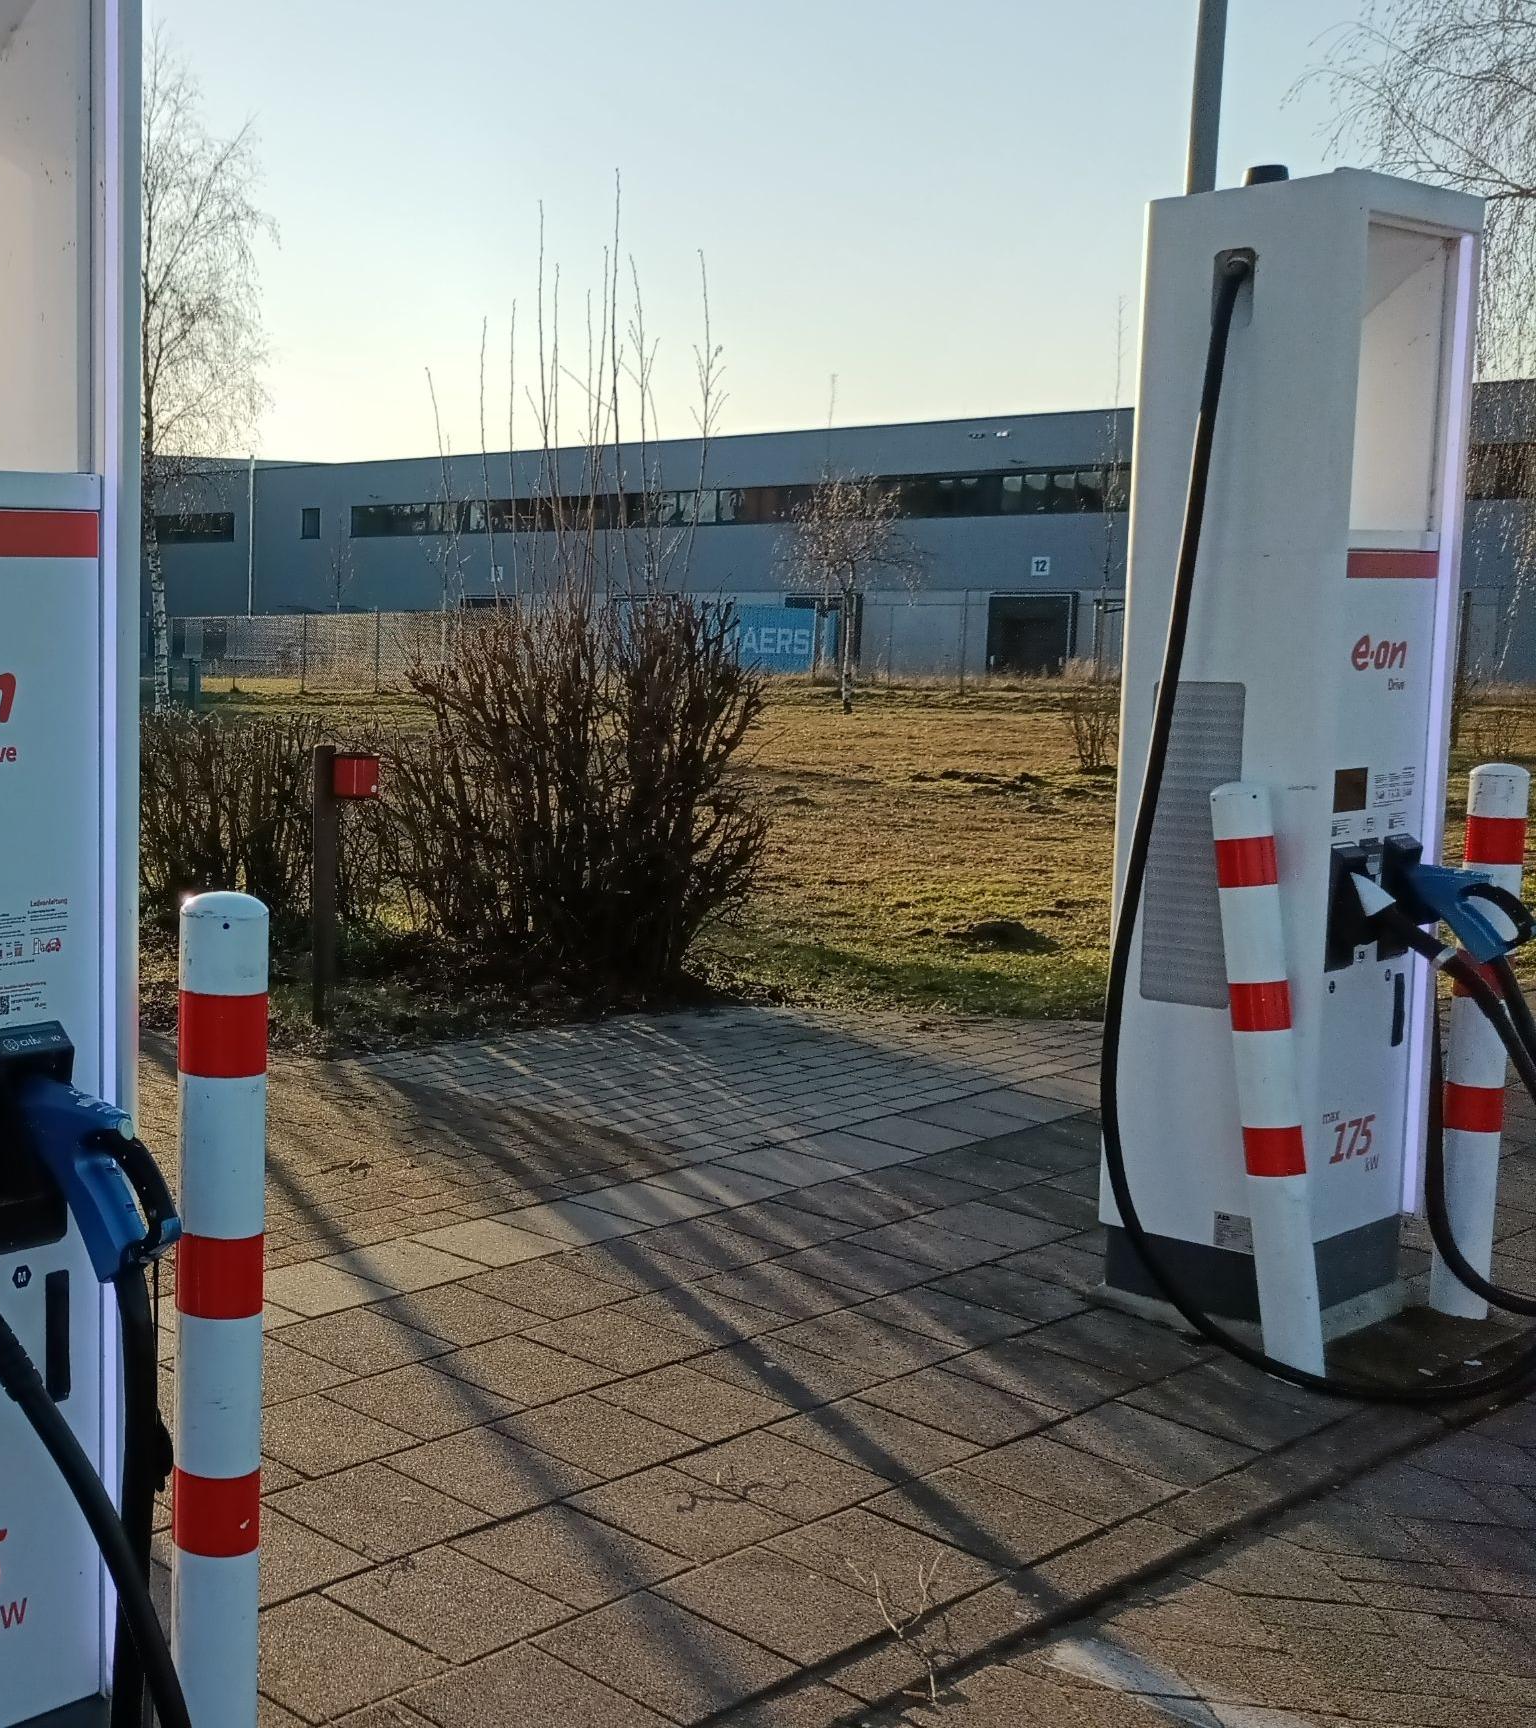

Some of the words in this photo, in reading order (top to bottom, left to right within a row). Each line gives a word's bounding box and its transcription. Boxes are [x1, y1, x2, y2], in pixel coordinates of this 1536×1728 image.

[1033, 559, 1047, 572] 12
[723, 626, 811, 655] AERS
[1322, 1111, 1340, 1124] max
[1329, 1113, 1376, 1165] 175
[17, 1270, 27, 1283] M
